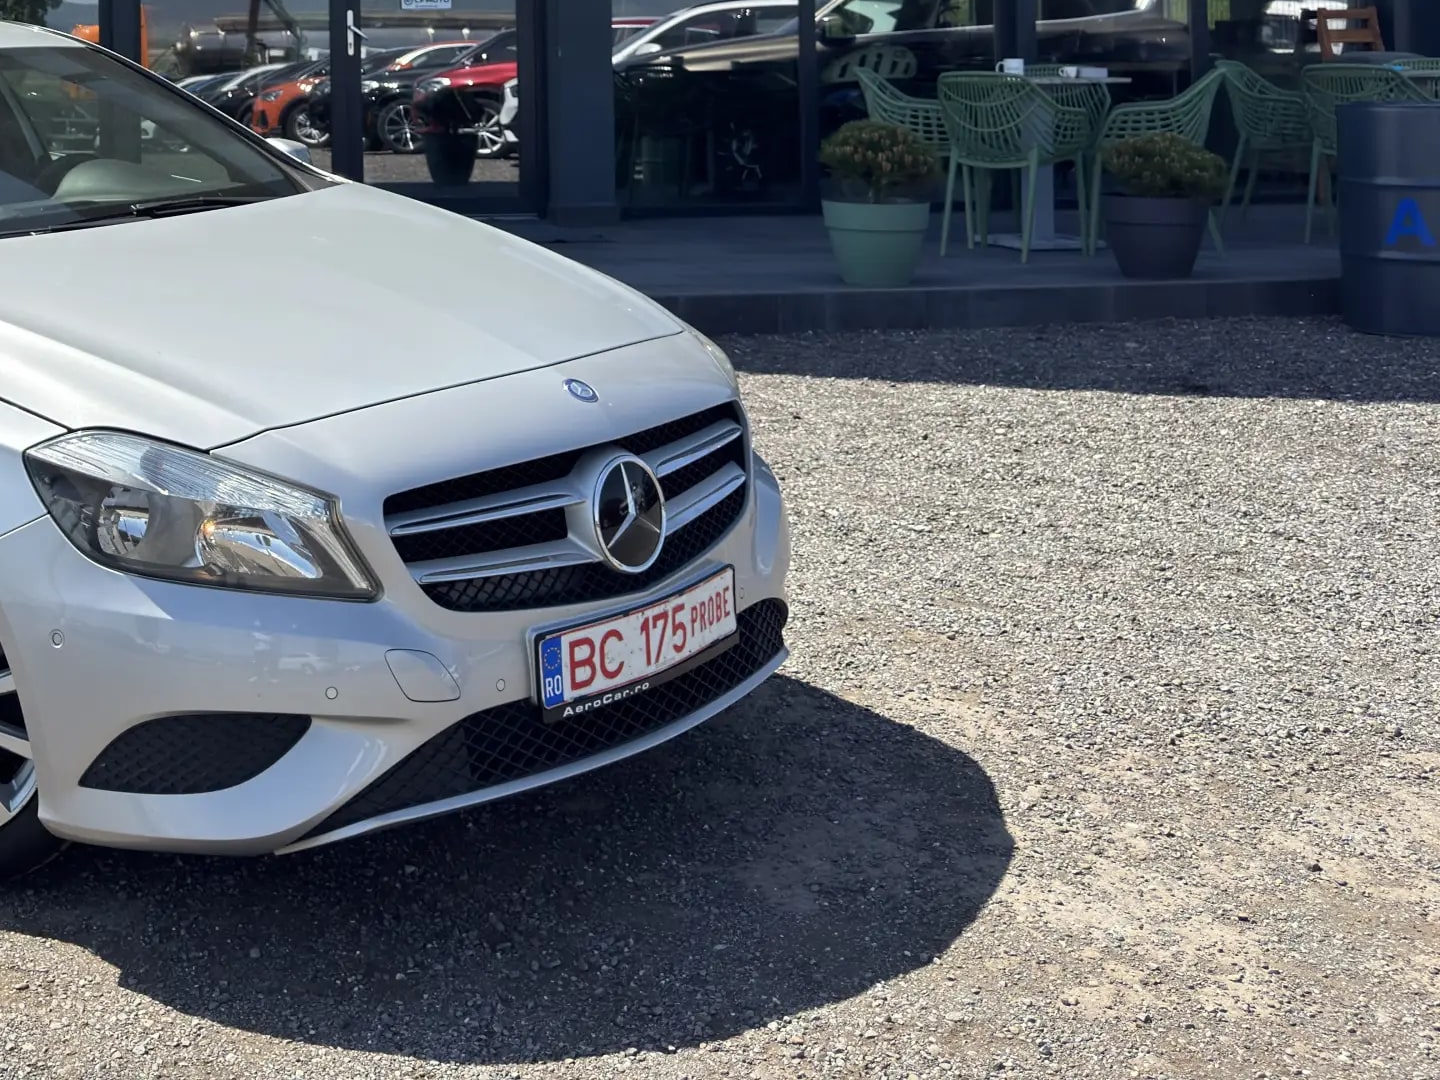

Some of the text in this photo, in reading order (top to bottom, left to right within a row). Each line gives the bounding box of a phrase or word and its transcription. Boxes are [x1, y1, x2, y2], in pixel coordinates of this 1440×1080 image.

[568, 585, 730, 692] BC 175 PROBE
[544, 674, 563, 699] RO
[563, 682, 650, 718] AeroCar.ro
